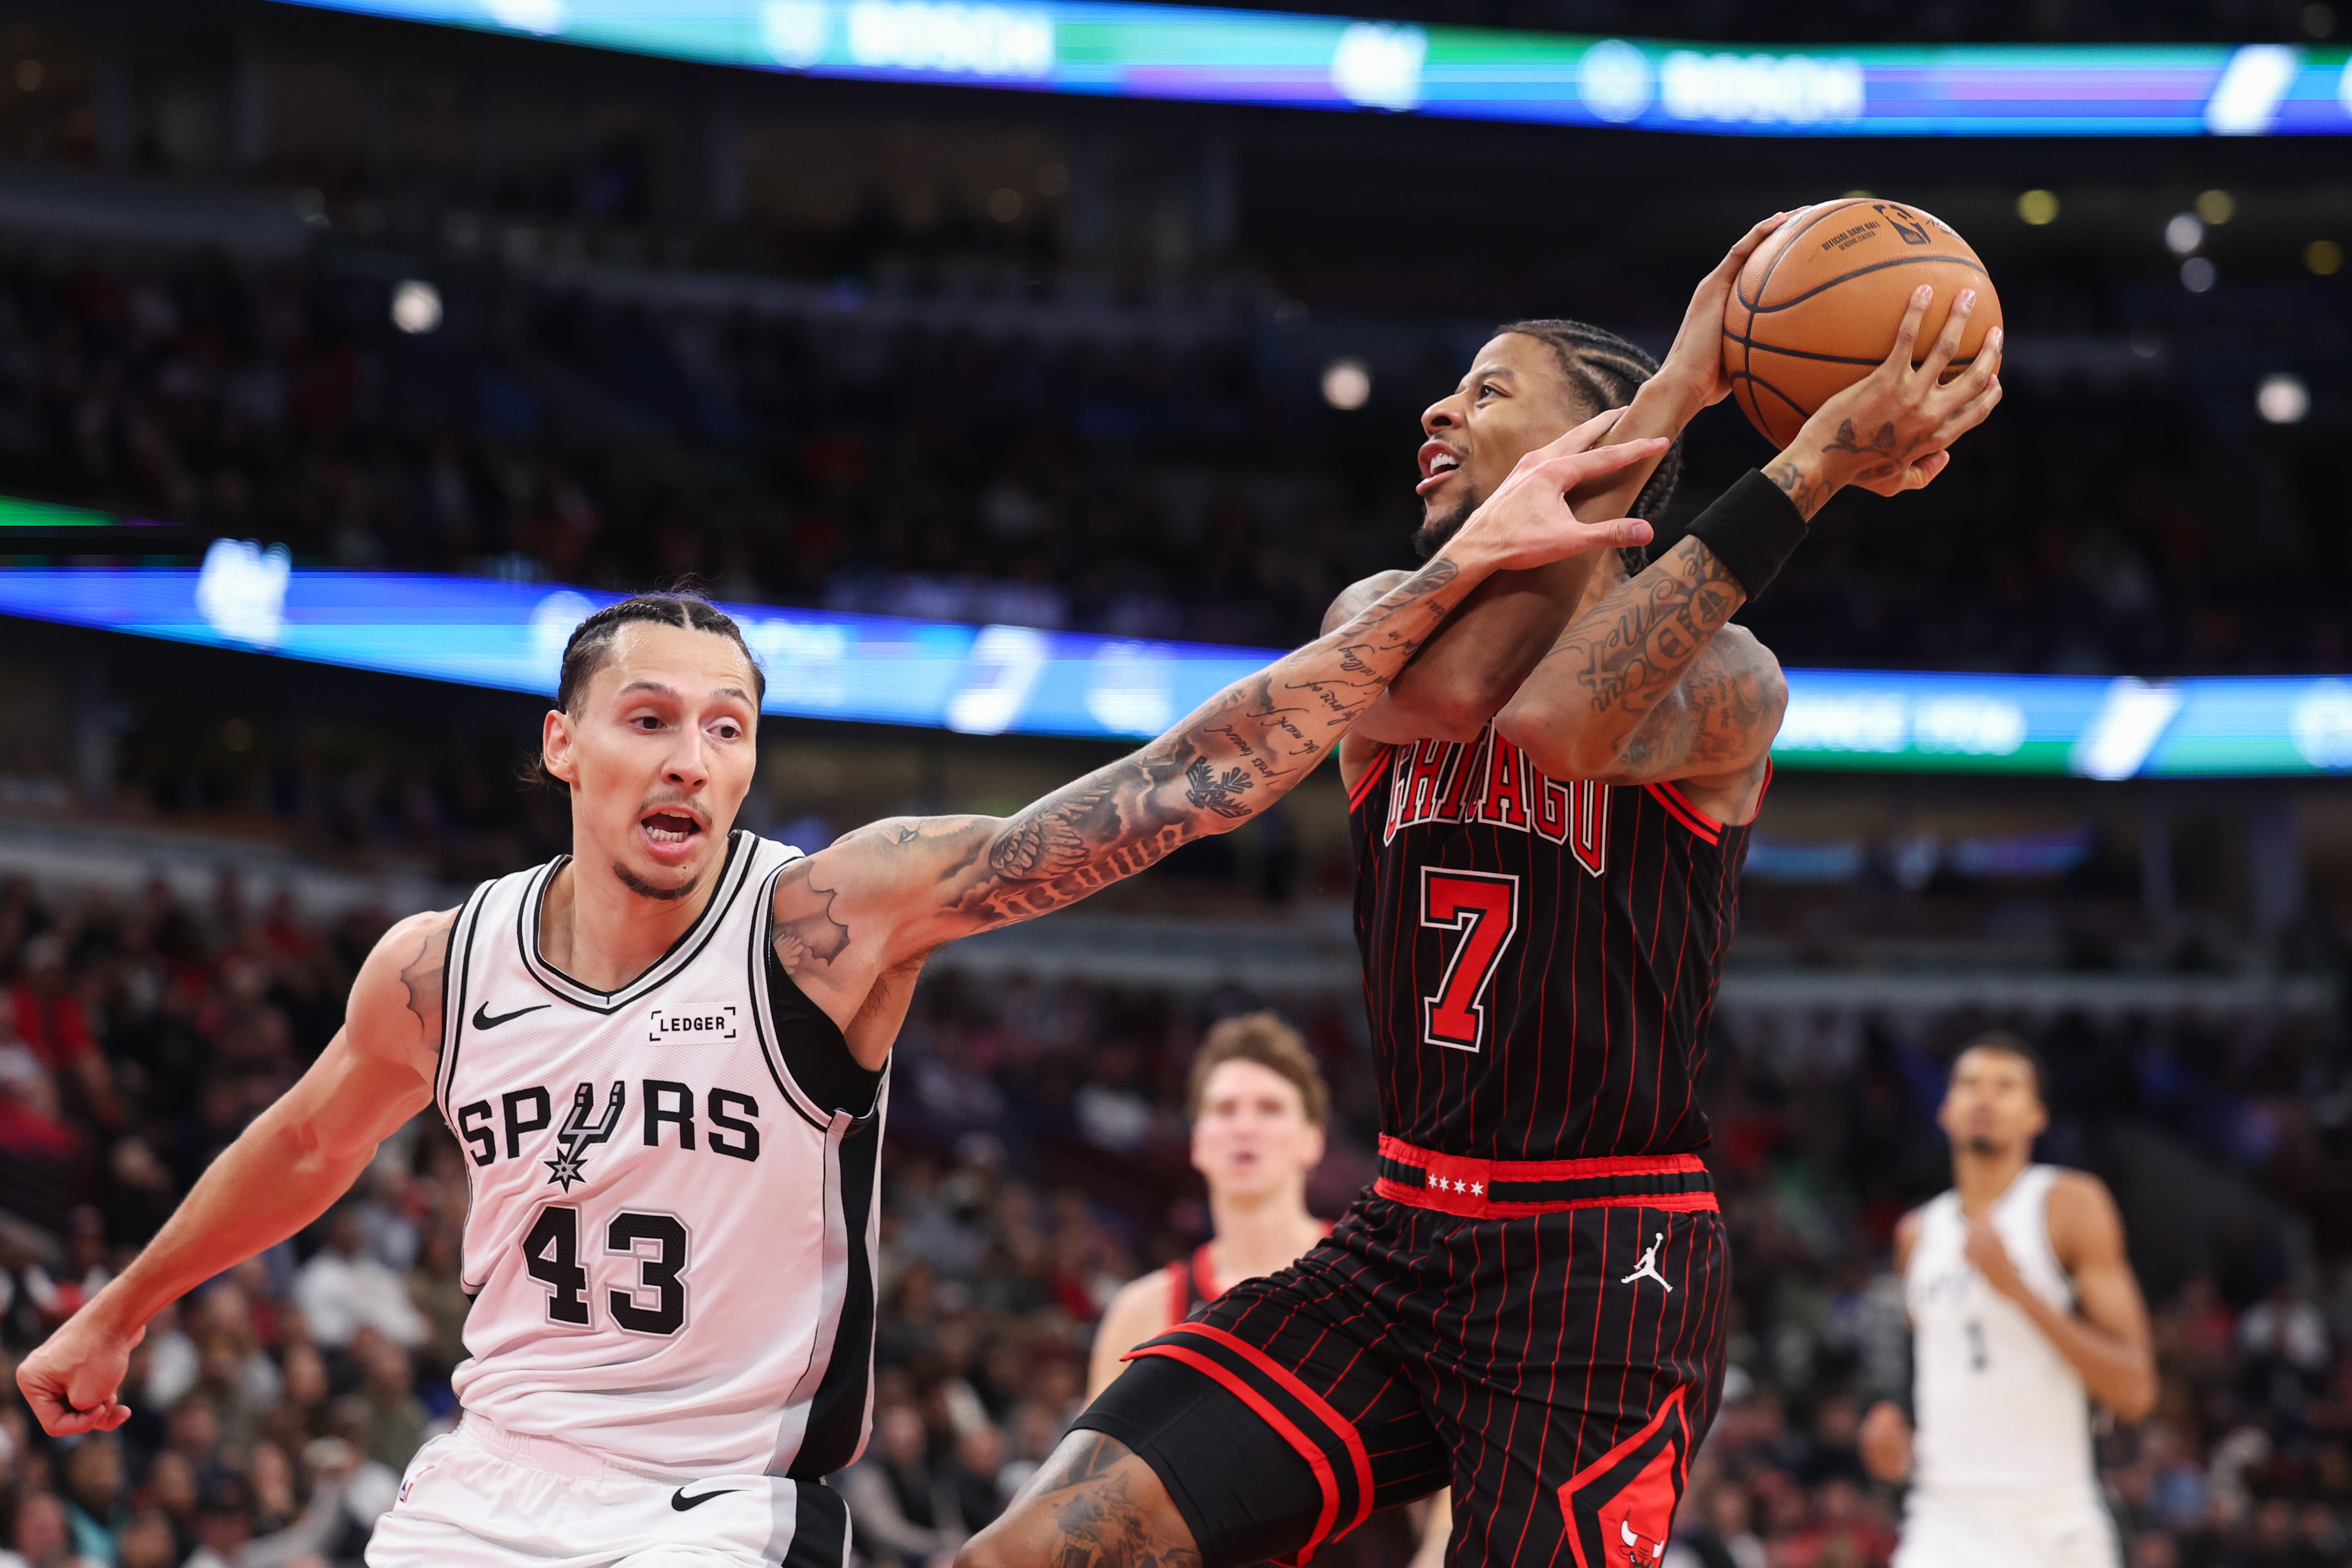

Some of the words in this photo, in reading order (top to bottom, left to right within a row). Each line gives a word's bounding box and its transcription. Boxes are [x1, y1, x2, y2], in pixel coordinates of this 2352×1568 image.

[1821, 232, 1849, 250] OFFICIAL
[1847, 225, 1866, 237] GAME
[1864, 221, 1880, 229] BALL
[1338, 645, 1376, 676] calling
[1246, 702, 1309, 717] for
[1320, 689, 1365, 711] prize
[1203, 724, 1254, 757] toward
[1261, 717, 1304, 739] mark
[1289, 740, 1320, 755] the
[1251, 757, 1298, 778] press
[1421, 865, 1520, 1053] 7
[660, 1016, 725, 1033] LEDGER
[458, 1079, 760, 1193] SPURS
[519, 1202, 692, 1339] 43
